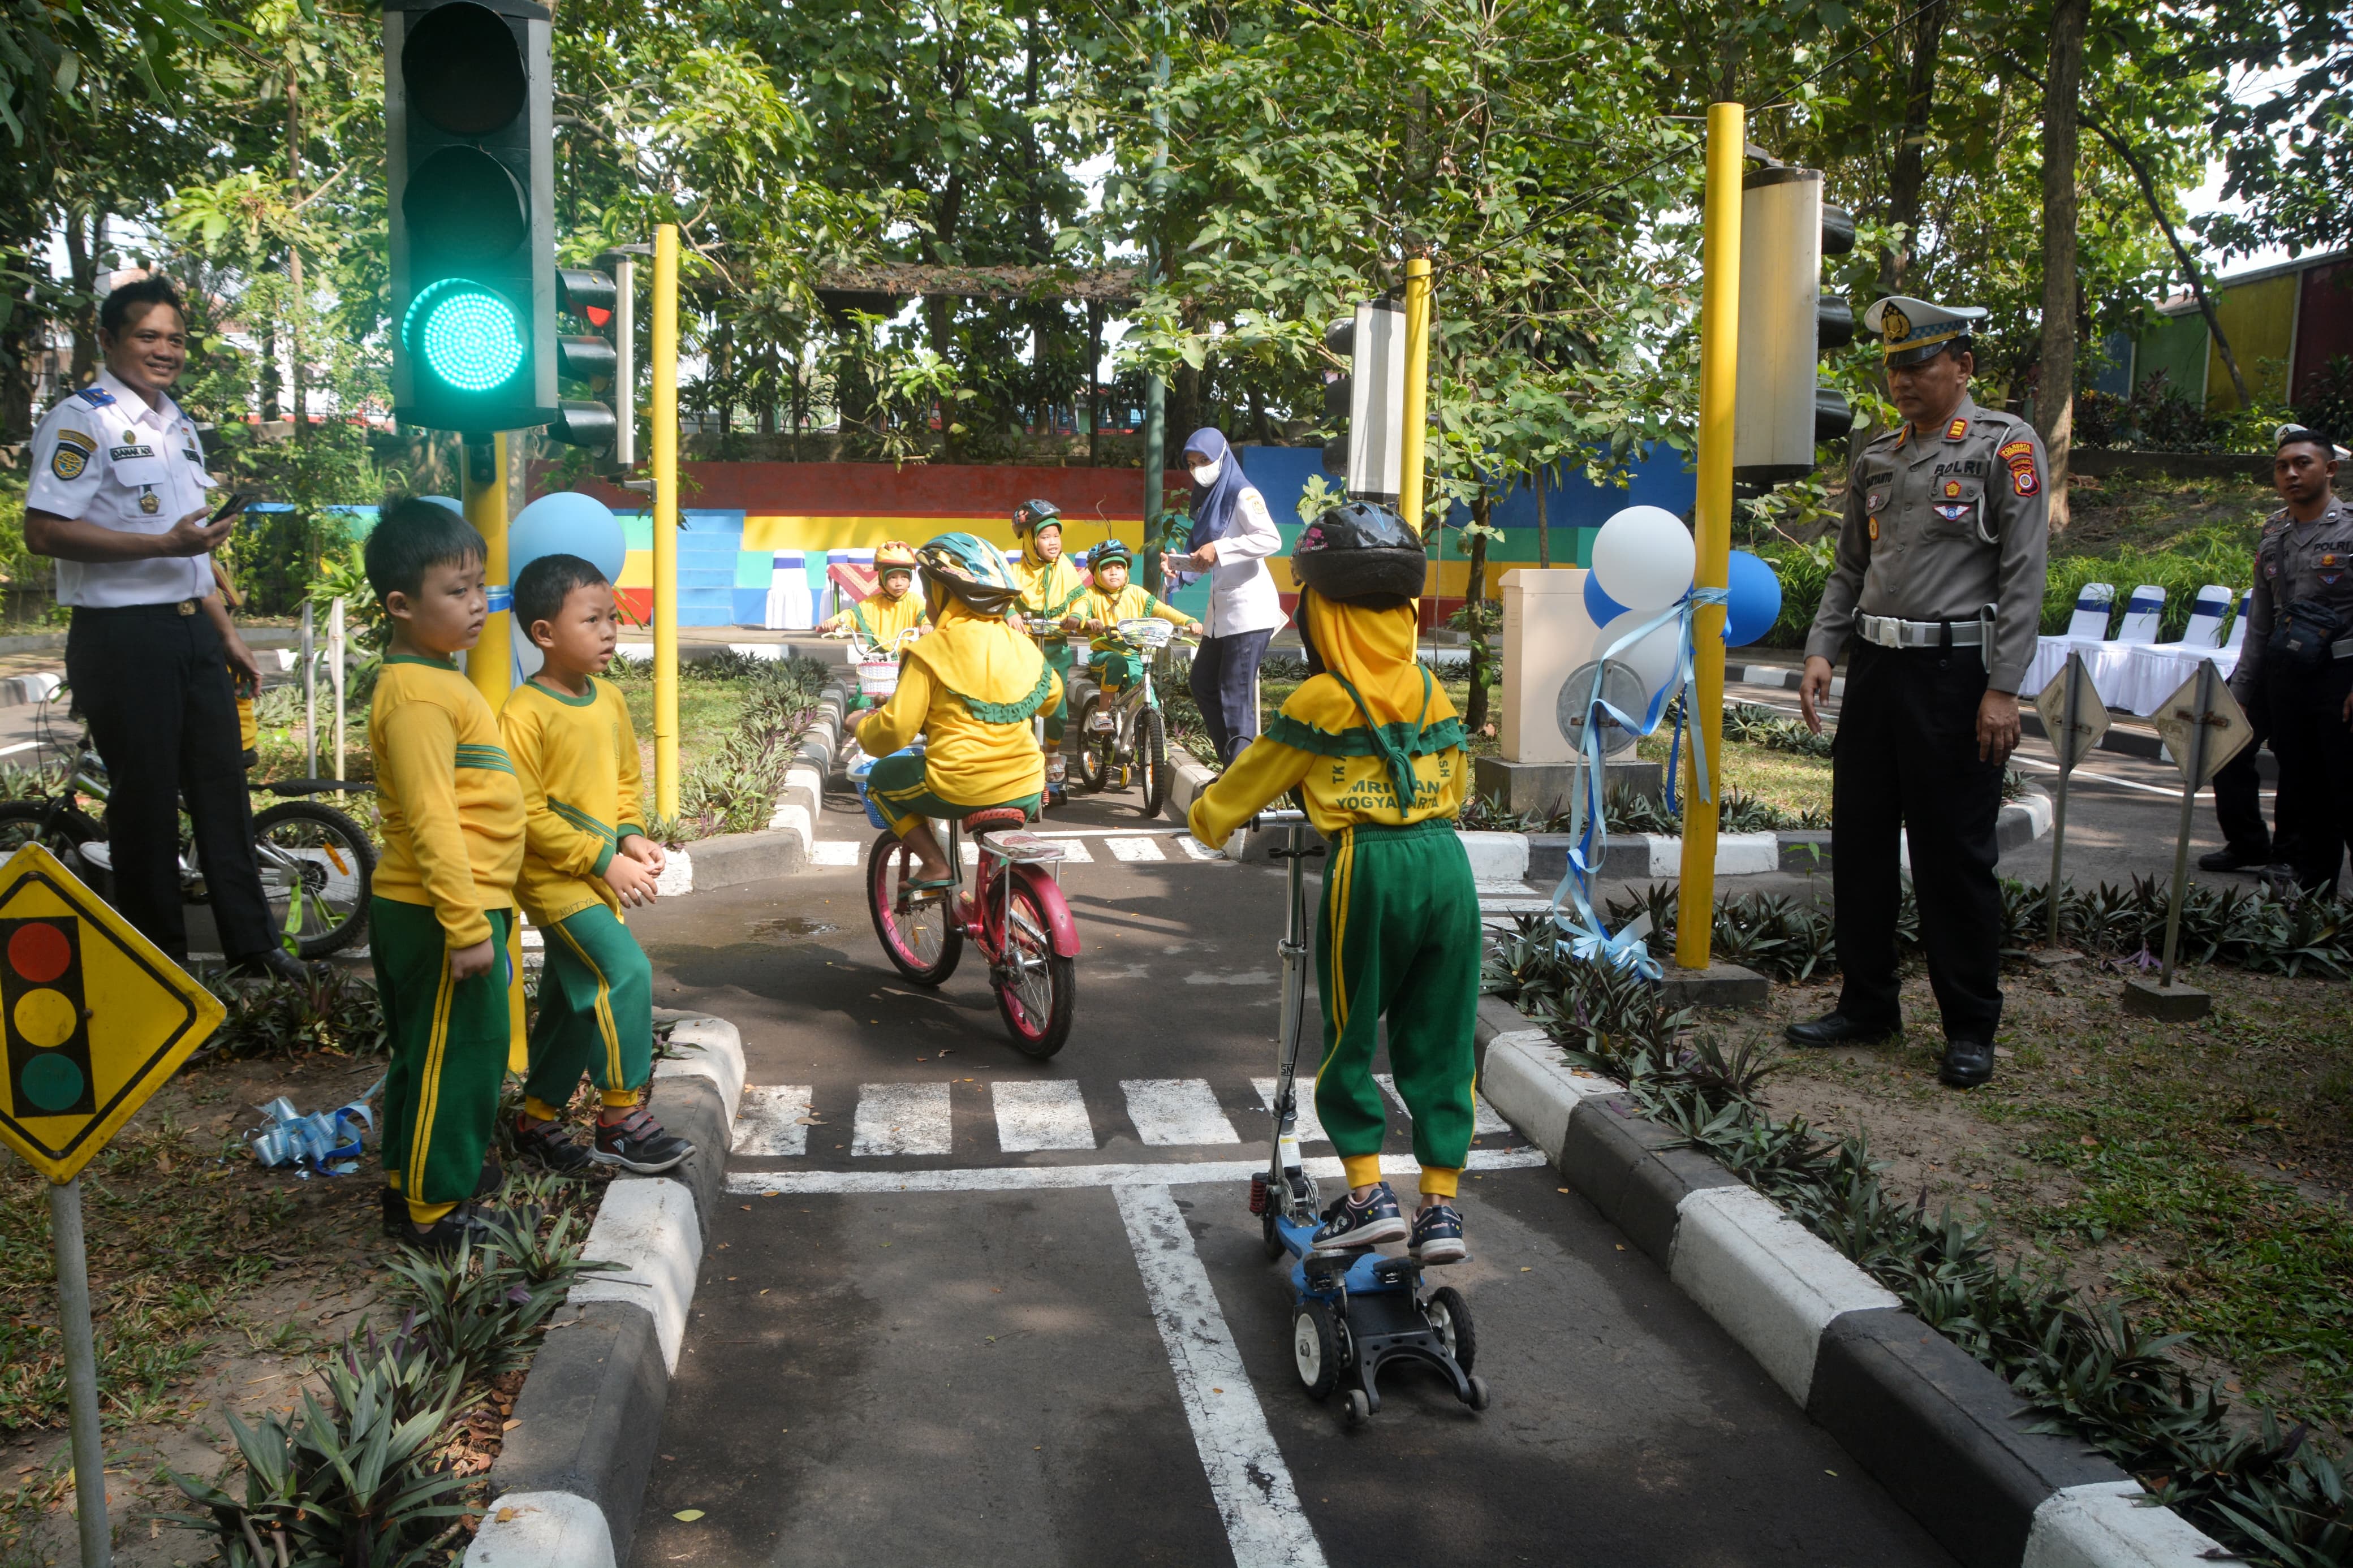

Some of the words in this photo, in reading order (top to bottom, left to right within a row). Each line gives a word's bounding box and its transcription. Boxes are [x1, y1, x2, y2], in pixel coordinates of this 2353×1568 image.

[1934, 460, 1981, 475] POLRI
[2314, 541, 2350, 552] POLRI
[1332, 764, 1345, 784] TK
[1347, 779, 1440, 794] MRIAN
[1335, 796, 1440, 810] YOGYAARTA
[560, 897, 597, 919] ADITYA
